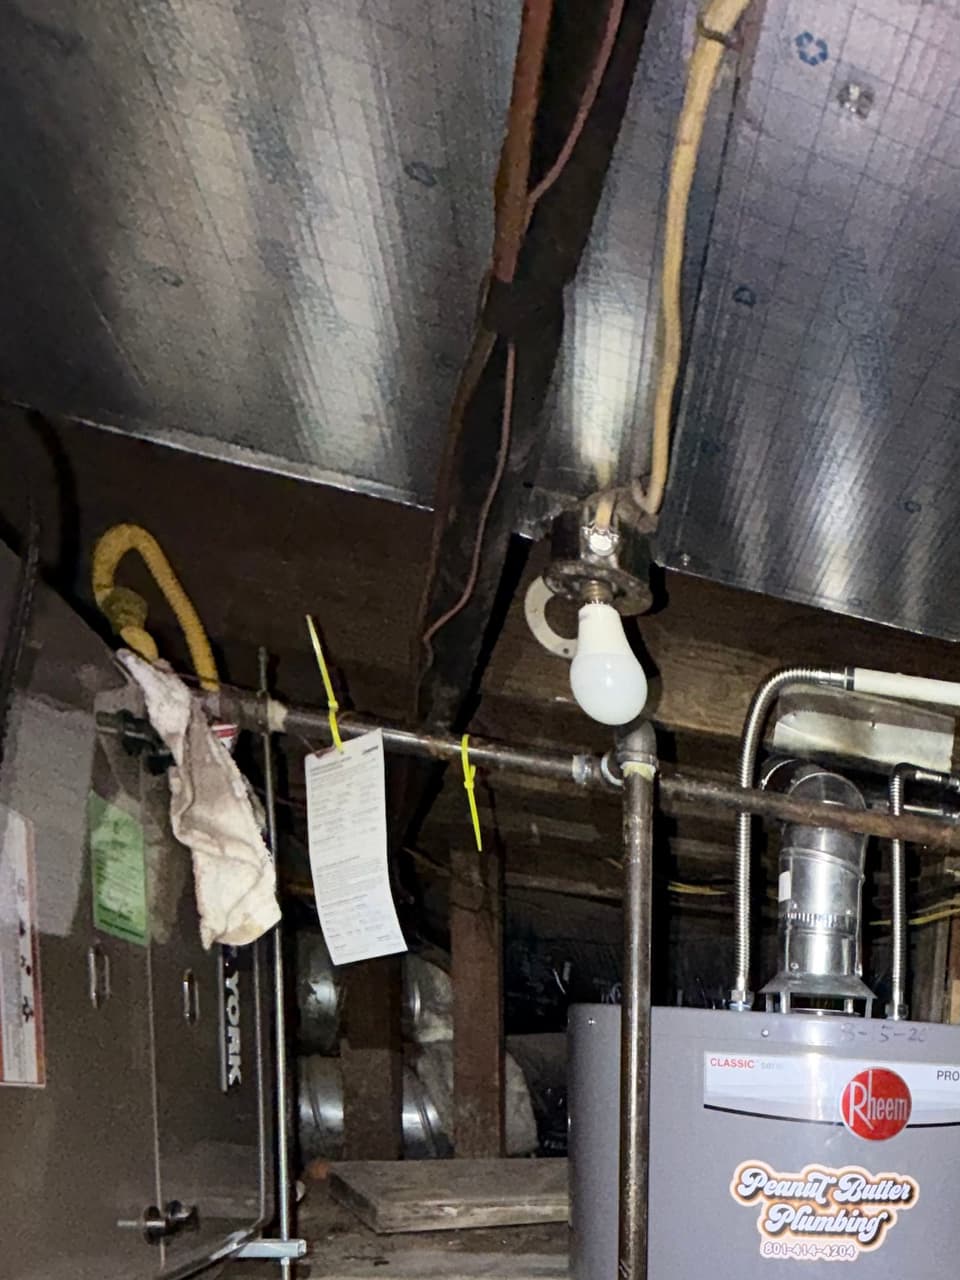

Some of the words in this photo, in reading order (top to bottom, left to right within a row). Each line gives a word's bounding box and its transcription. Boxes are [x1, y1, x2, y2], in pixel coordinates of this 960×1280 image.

[226, 970, 242, 1086] YORK
[710, 1057, 755, 1069] CLASSIC
[848, 1070, 909, 1130] Rheem
[736, 1168, 837, 1205] Peanut
[833, 1173, 912, 1203] Butter
[764, 1204, 889, 1244] Plumbing
[763, 1241, 856, 1257] 801-414-4204
